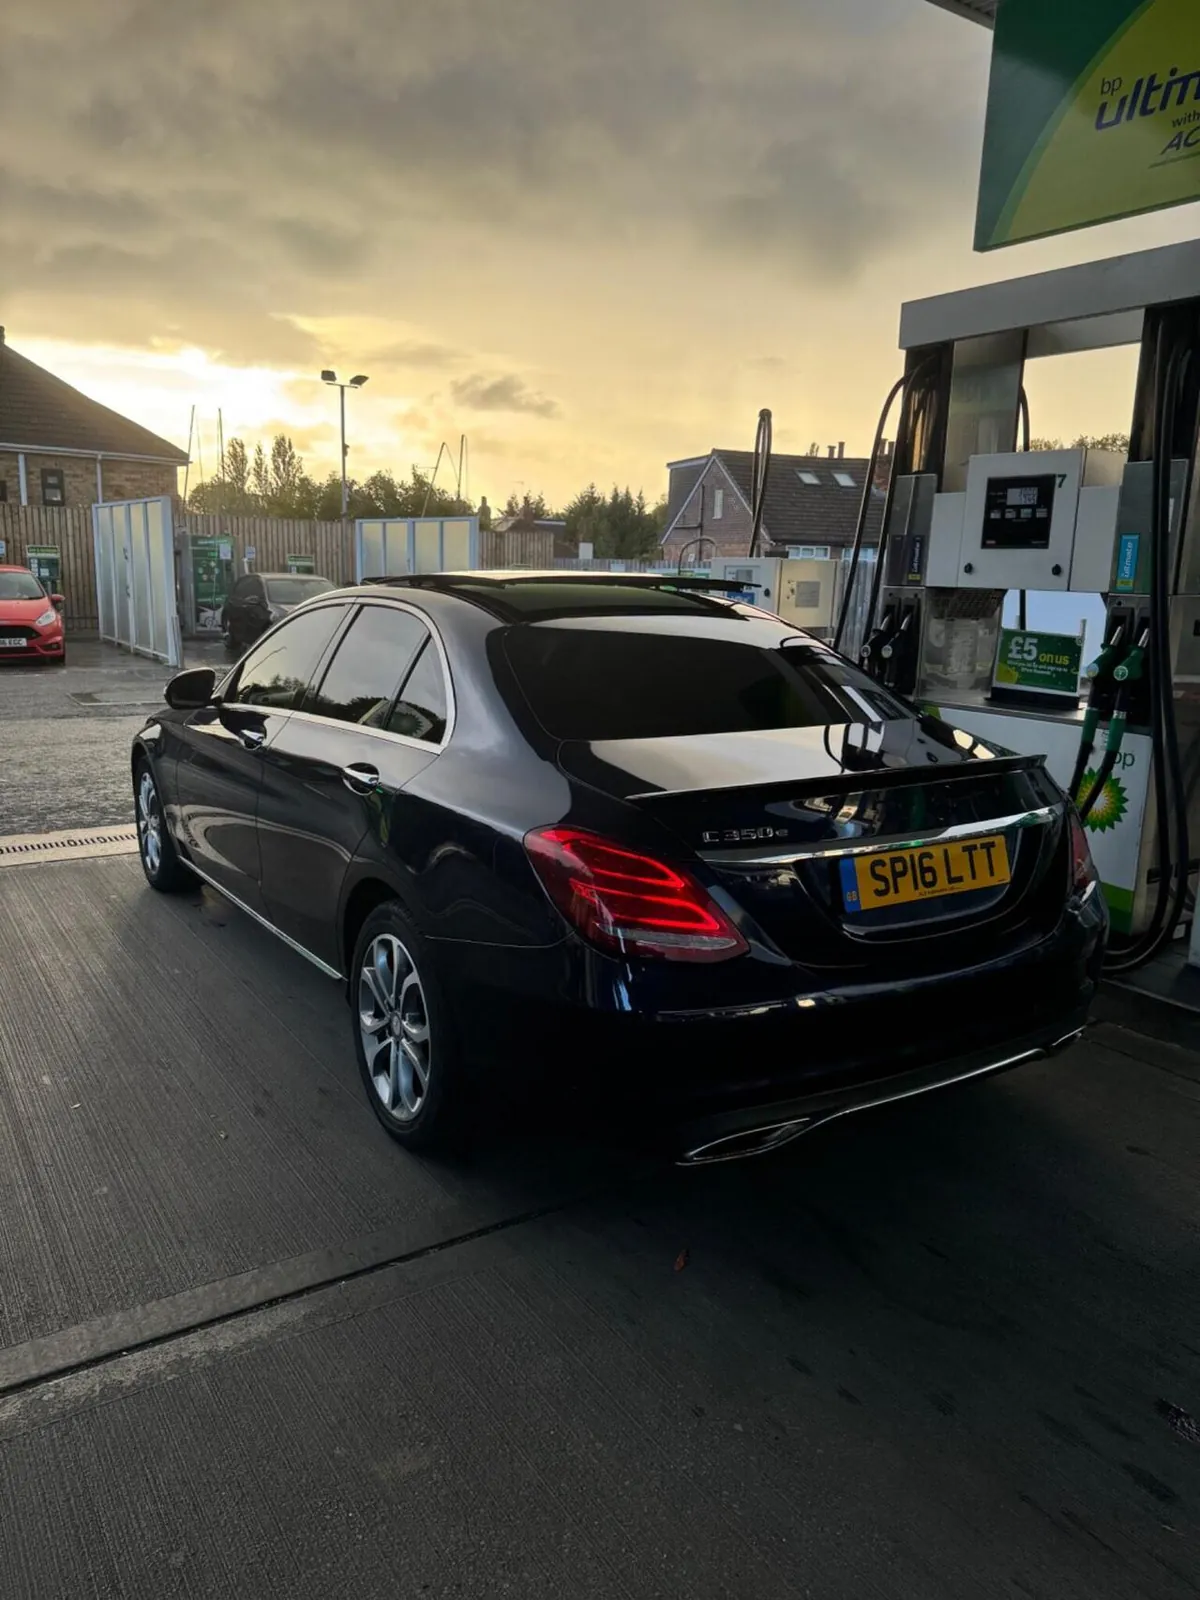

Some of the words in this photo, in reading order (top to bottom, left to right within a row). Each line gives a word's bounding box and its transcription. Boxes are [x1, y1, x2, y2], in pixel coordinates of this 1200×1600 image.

[1100, 77, 1122, 96] bp
[1057, 473, 1067, 488] 7
[1007, 636, 1038, 661] £5
[870, 851, 938, 897] SP16
[943, 841, 996, 885] LTT
